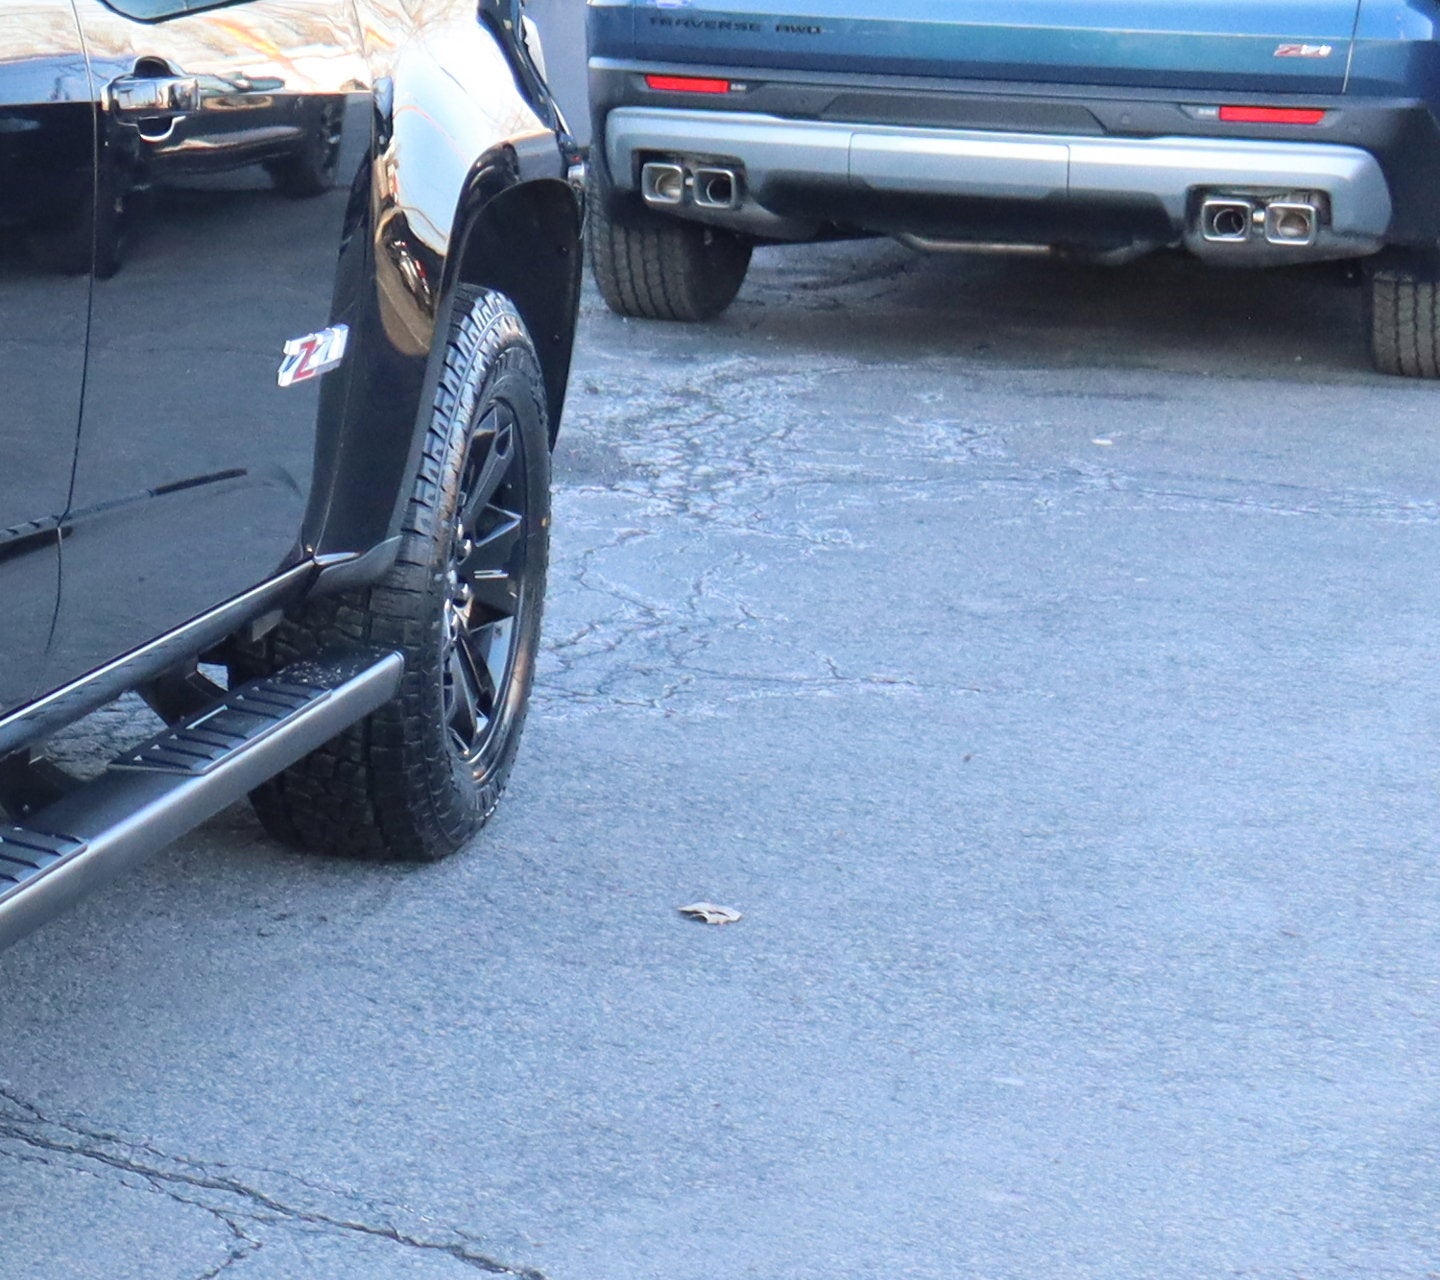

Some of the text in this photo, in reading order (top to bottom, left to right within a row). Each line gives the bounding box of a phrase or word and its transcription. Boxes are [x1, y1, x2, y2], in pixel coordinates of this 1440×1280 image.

[649, 16, 822, 35] TRAVERSE AWD
[278, 323, 350, 387] Z71
